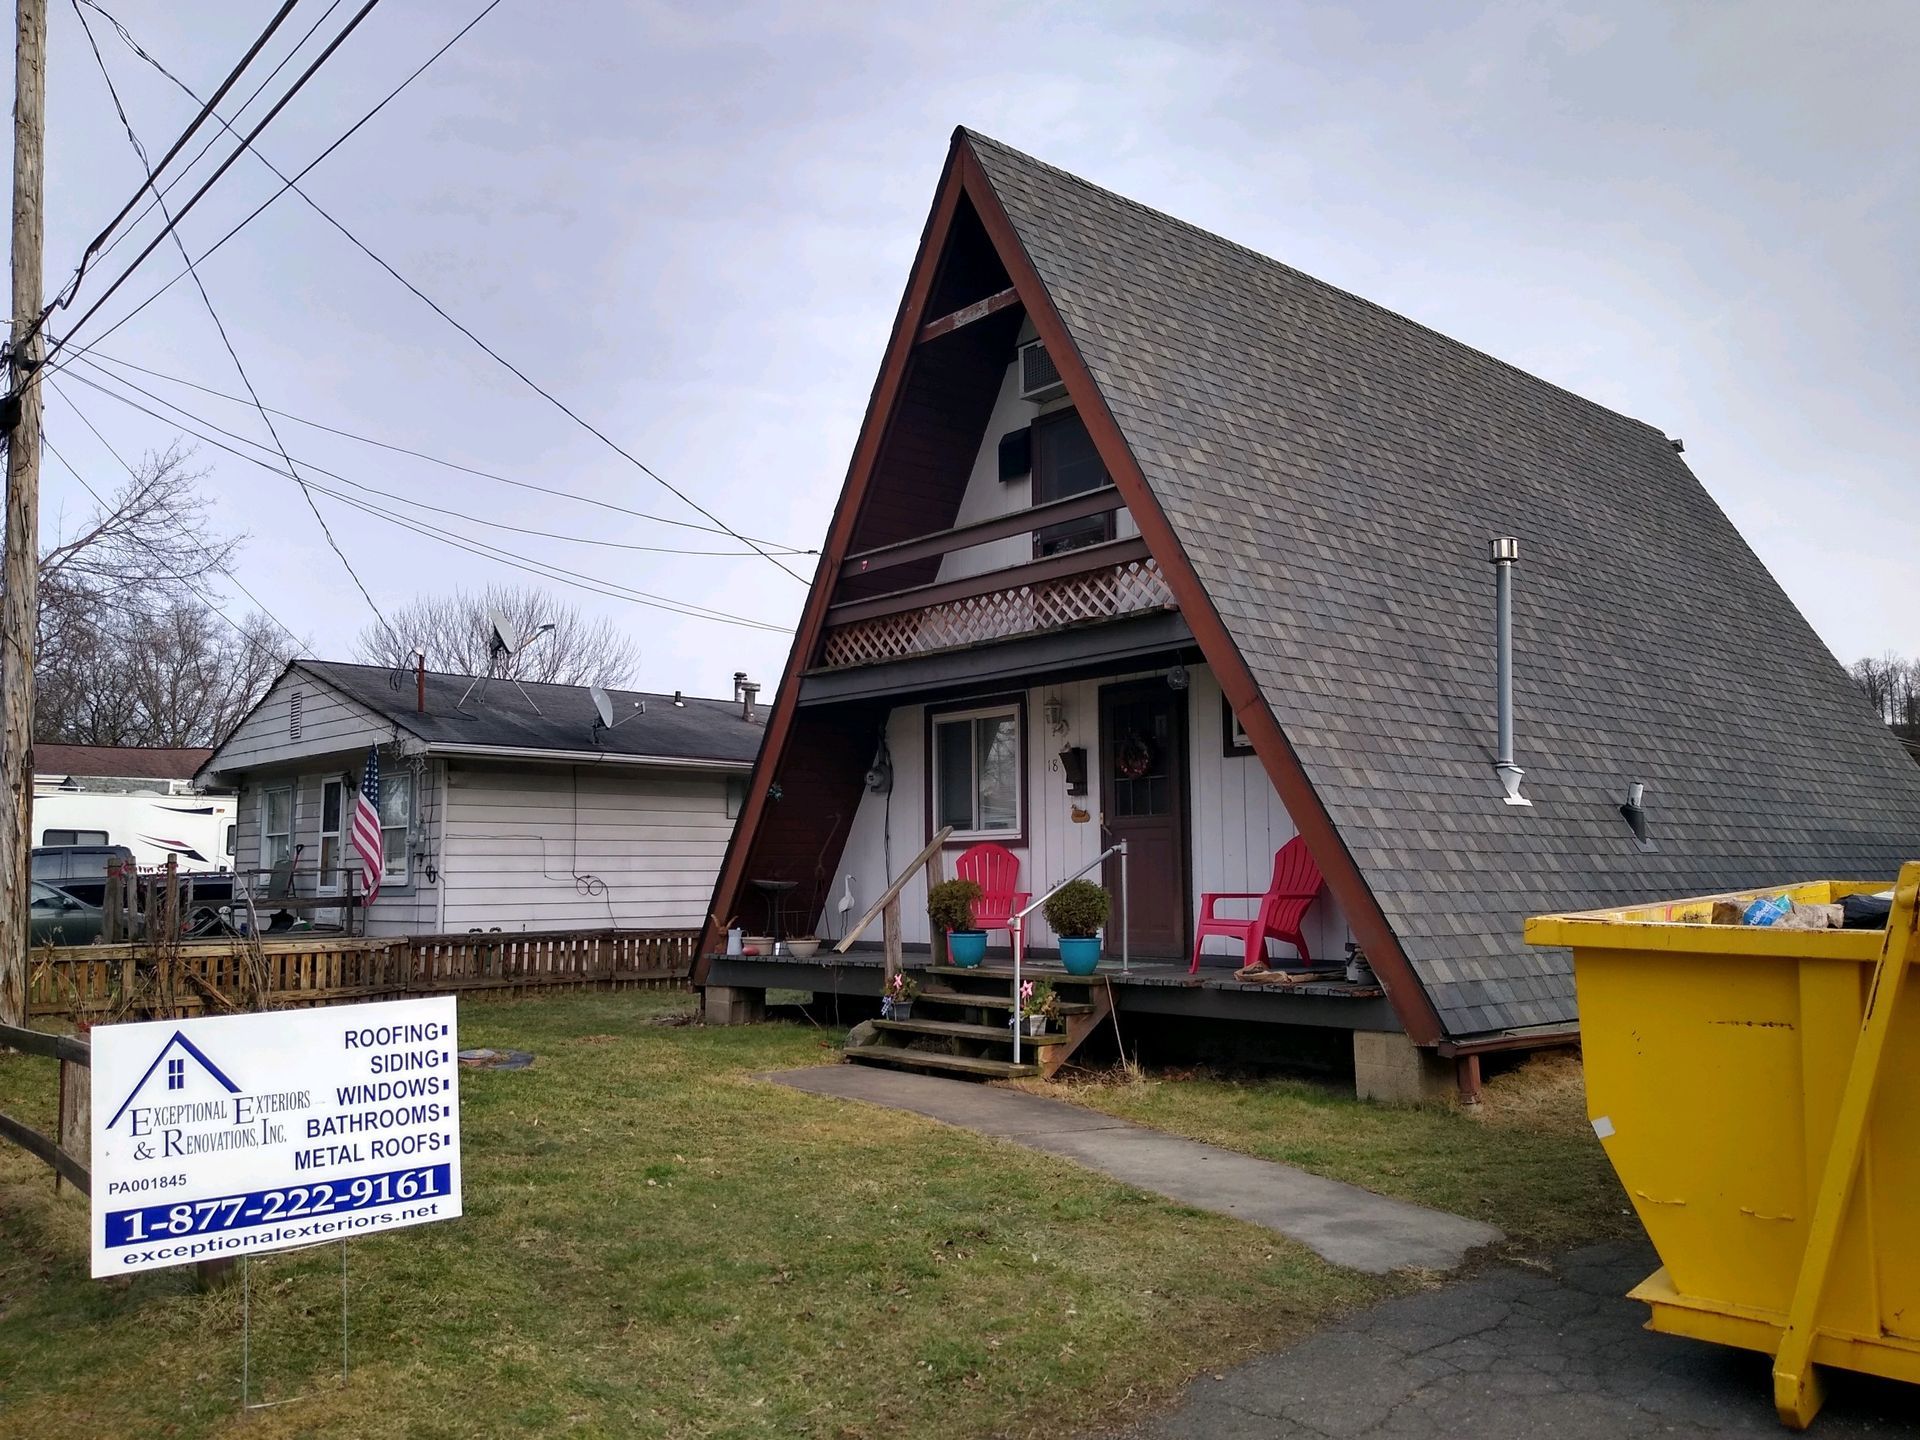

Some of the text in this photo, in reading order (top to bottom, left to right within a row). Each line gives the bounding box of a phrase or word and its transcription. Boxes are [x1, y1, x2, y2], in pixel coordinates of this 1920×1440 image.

[1047, 759, 1059, 772] 18
[345, 1022, 439, 1049] ROOFING
[370, 1049, 439, 1074] SIDING
[336, 1076, 440, 1106] WINDOWS
[128, 1090, 311, 1137] EXCEPTIONAL EXTERIORS
[307, 1103, 440, 1139] BATHROOMS
[133, 1117, 287, 1161] & RENOVATIONS, INC.
[295, 1132, 441, 1171] METAL ROOFS
[108, 1173, 188, 1195] PA001845
[123, 1168, 439, 1241] 1-877-222-9161
[123, 1203, 438, 1265] exceptionalexteriors.net
